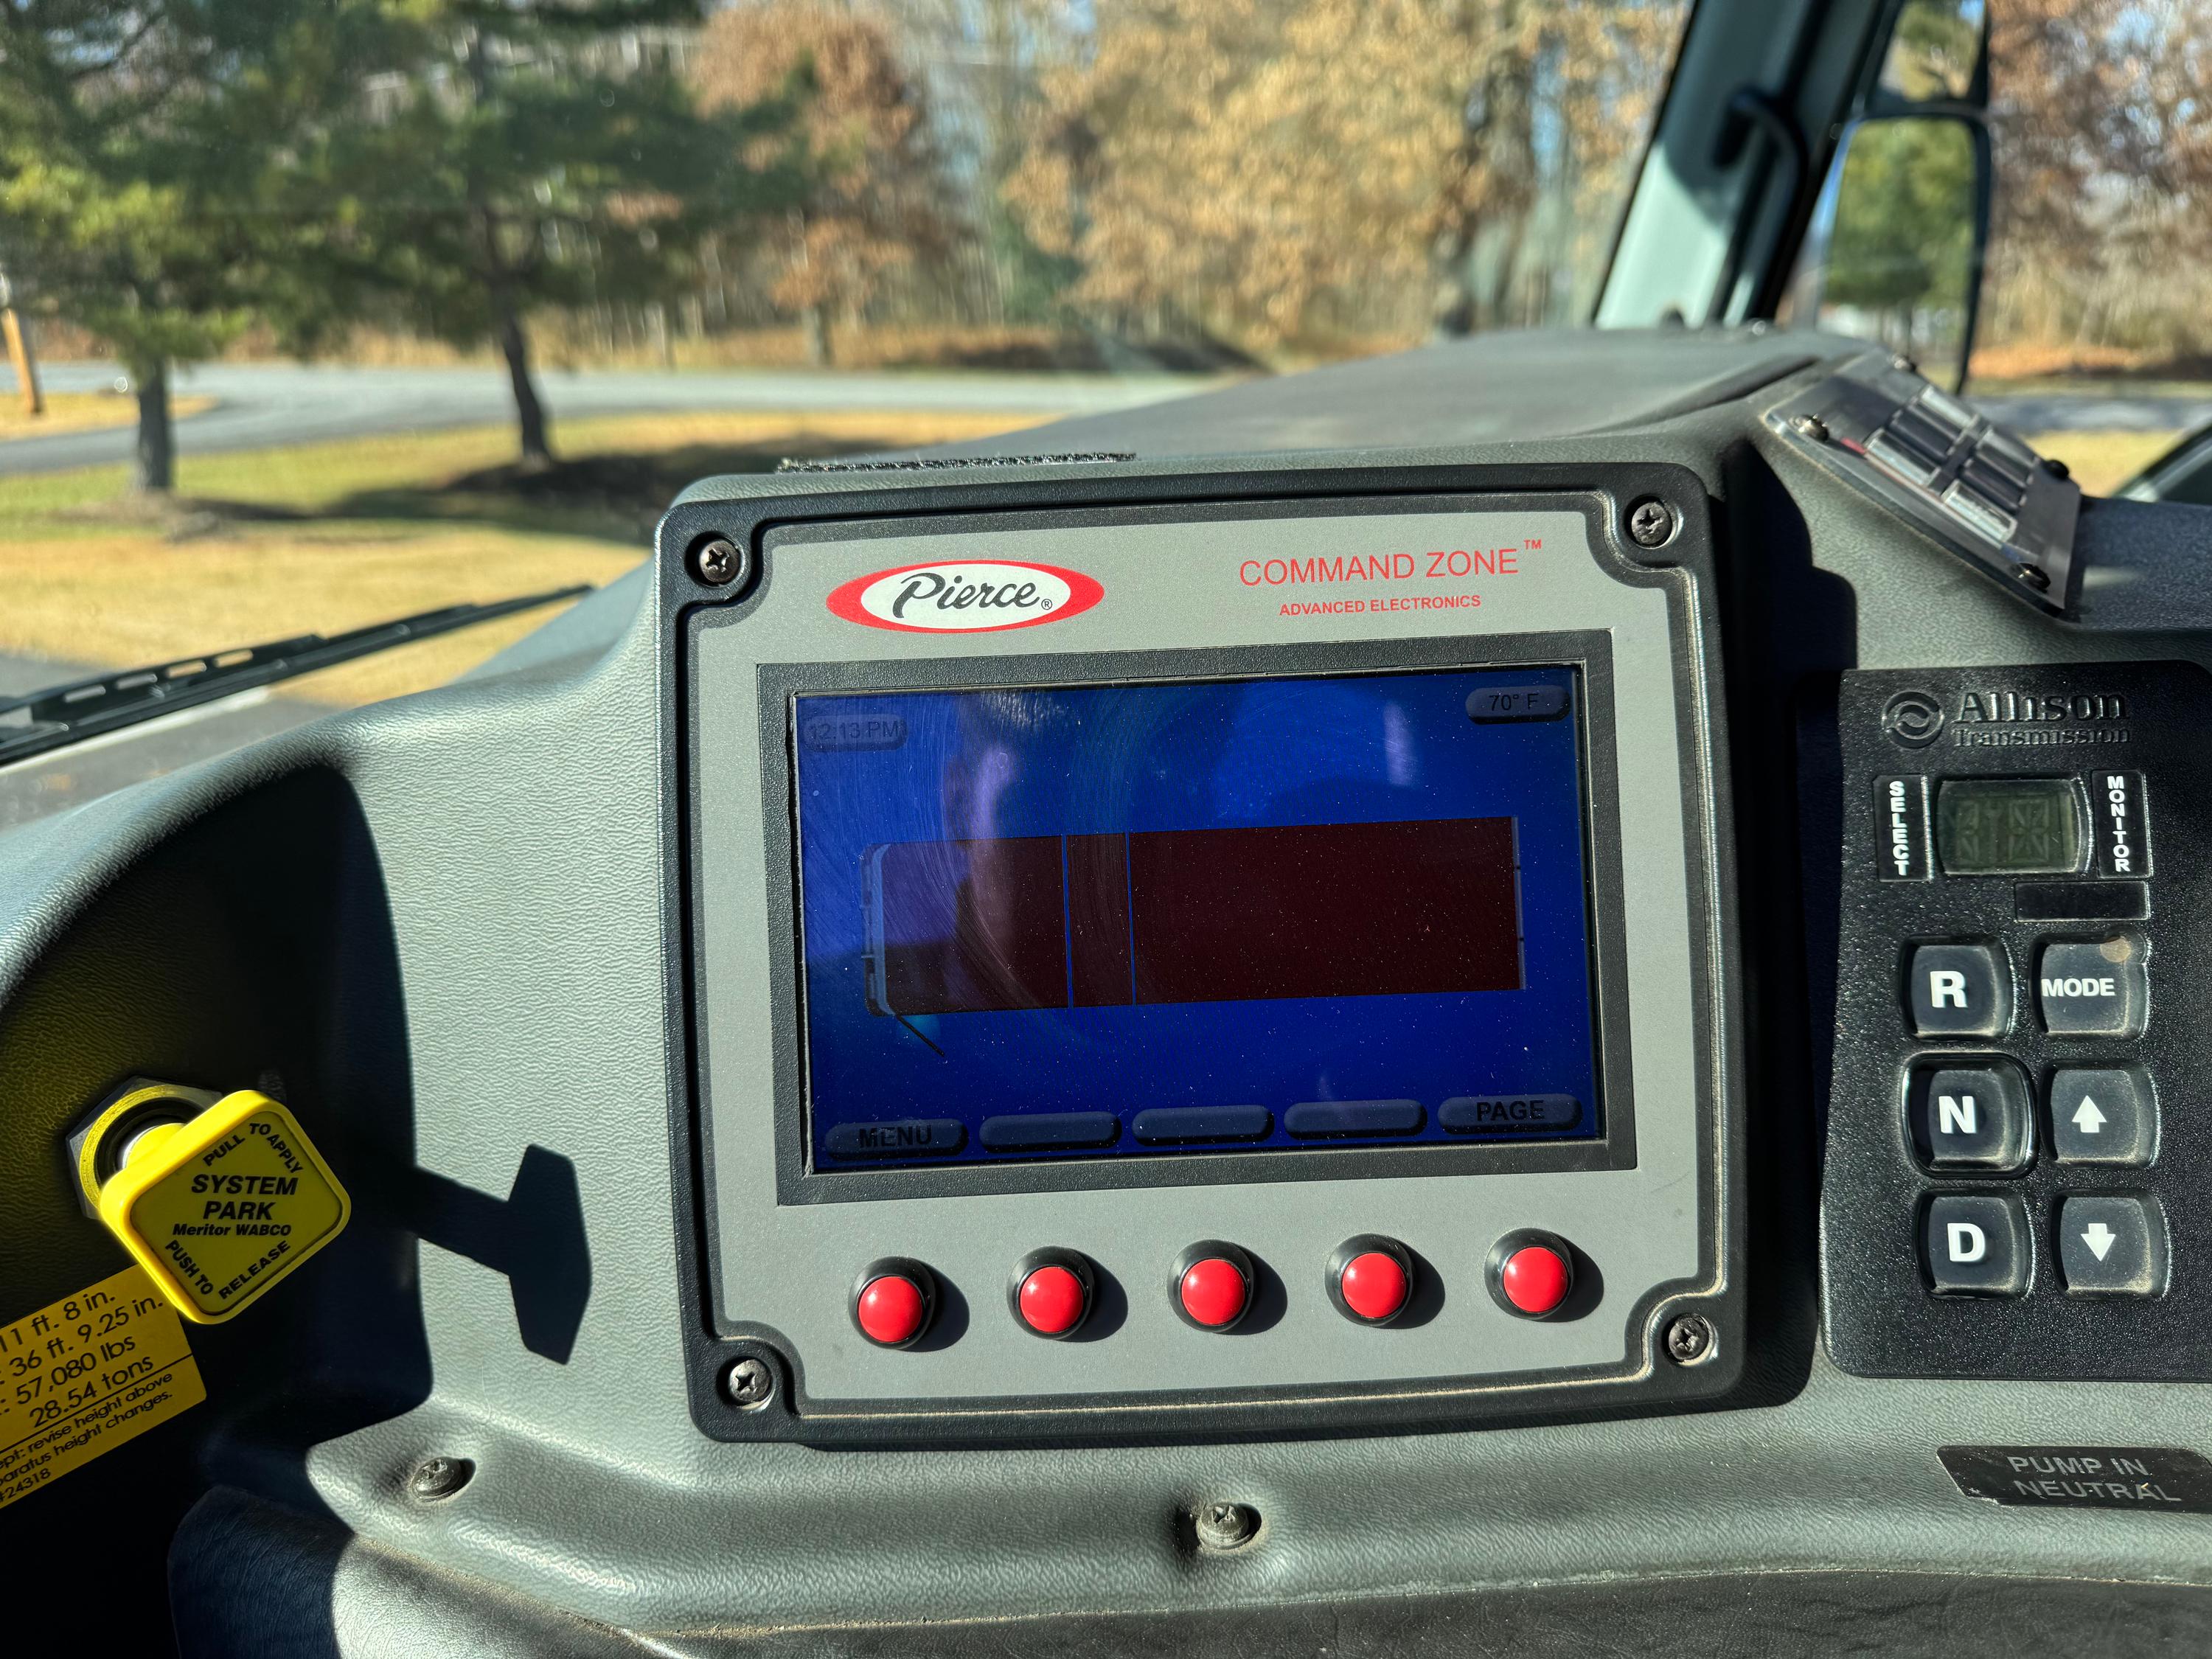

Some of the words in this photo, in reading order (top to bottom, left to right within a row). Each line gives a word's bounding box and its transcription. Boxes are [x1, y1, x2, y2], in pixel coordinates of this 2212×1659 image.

[1239, 553, 1415, 586] COMMAND
[1425, 548, 1519, 578] ZONE
[1279, 600, 1366, 616] ADVANCED
[1370, 594, 1481, 612] ELECTRONICS
[1527, 693, 1538, 709] F
[1952, 692, 2130, 723] Allison
[1952, 728, 2131, 747] Transmission
[1889, 781, 1910, 876] SELECT
[2107, 776, 2130, 872] MONITOR
[1930, 970, 1968, 1008] R
[2041, 978, 2115, 996] MODE
[1477, 1100, 1545, 1121] PAGE
[1938, 1096, 1977, 1134] N
[203, 1135, 246, 1166] PULL
[249, 1123, 271, 1135] TO
[267, 1134, 303, 1174] APPLY
[859, 1125, 932, 1148] MENU
[191, 1174, 299, 1195] SYSTEM
[203, 1200, 276, 1220] PARK
[173, 1223, 231, 1236] Meritor
[235, 1224, 292, 1236] WABCO
[1947, 1223, 1986, 1262] D
[165, 1239, 200, 1278] PUSH
[195, 1273, 214, 1295] TO
[218, 1240, 291, 1300] RELEASE
[32, 1315, 60, 1336] ft.
[63, 1301, 81, 1321] 8
[83, 1292, 116, 1311] in.
[9, 1349, 42, 1377] 36
[46, 1338, 74, 1359] ft.
[77, 1306, 130, 1343] 9.25
[132, 1297, 163, 1317] in.
[16, 1352, 97, 1405] 57,080
[100, 1336, 136, 1362] lbs
[29, 1381, 97, 1428] 28.54
[102, 1357, 153, 1390] tons
[29, 1425, 72, 1453] revise
[74, 1397, 122, 1428] height
[125, 1374, 173, 1402] above
[54, 1424, 102, 1456] height
[105, 1391, 173, 1429] changes.
[2007, 1456, 2102, 1474] PUMP
[2110, 1458, 2149, 1475] IN
[2014, 1480, 2181, 1501] NEUTRAL
